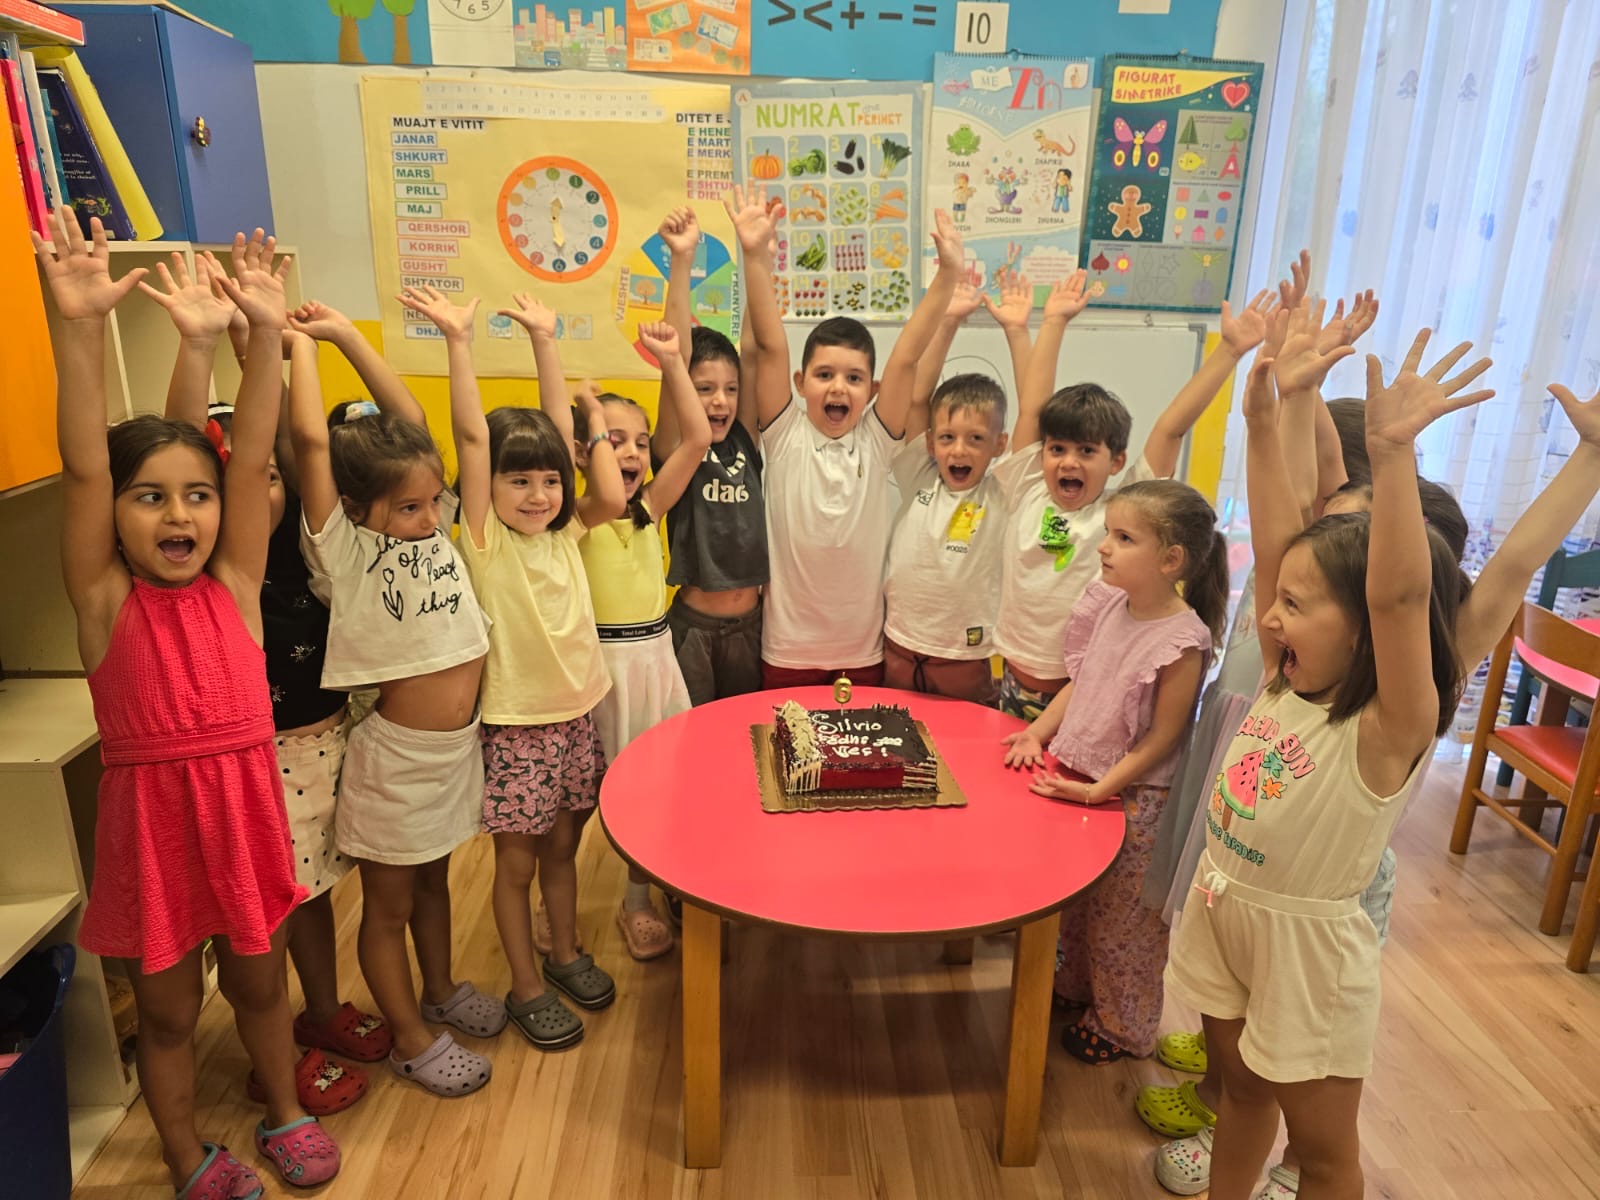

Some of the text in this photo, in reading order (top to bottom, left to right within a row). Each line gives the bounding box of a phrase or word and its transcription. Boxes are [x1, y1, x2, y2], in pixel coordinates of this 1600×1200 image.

[468, 4, 476, 14] 6
[481, 1, 490, 11] 5
[966, 12, 991, 45] 10
[1118, 71, 1176, 85] FIGURAT
[1115, 84, 1182, 101] SIMETRIKE
[676, 113, 712, 123] DITET
[716, 114, 723, 123] E
[755, 102, 861, 128] NUMRAT
[393, 117, 484, 130] MUAJT E VITIT
[688, 127, 695, 136] E
[394, 135, 435, 144] JANAR
[687, 138, 731, 147] E MART
[789, 137, 799, 153] 2
[831, 137, 840, 152] 3
[871, 136, 882, 152] 4
[395, 151, 445, 161] SHKURT
[687, 148, 731, 158] E MERK
[396, 168, 431, 179] MARS
[687, 170, 733, 179] E PREMT
[406, 186, 440, 196] PRILL
[687, 180, 734, 190] E SHTUN
[687, 190, 694, 199] E
[407, 204, 432, 214] MAJ
[408, 222, 466, 234] QERSHOR
[792, 232, 810, 247] 10
[832, 230, 847, 246] 11
[409, 242, 457, 253] KORRIK
[578, 254, 585, 263] 5
[403, 261, 444, 271] GUSHT
[555, 260, 563, 270] 6
[403, 277, 461, 289] SHTATOR
[616, 266, 630, 322] VJESHTE
[398, 545, 423, 578] of
[416, 591, 462, 616] thing
[833, 677, 852, 704] 6
[812, 713, 882, 734] Silvio
[1275, 732, 1316, 780] SUN
